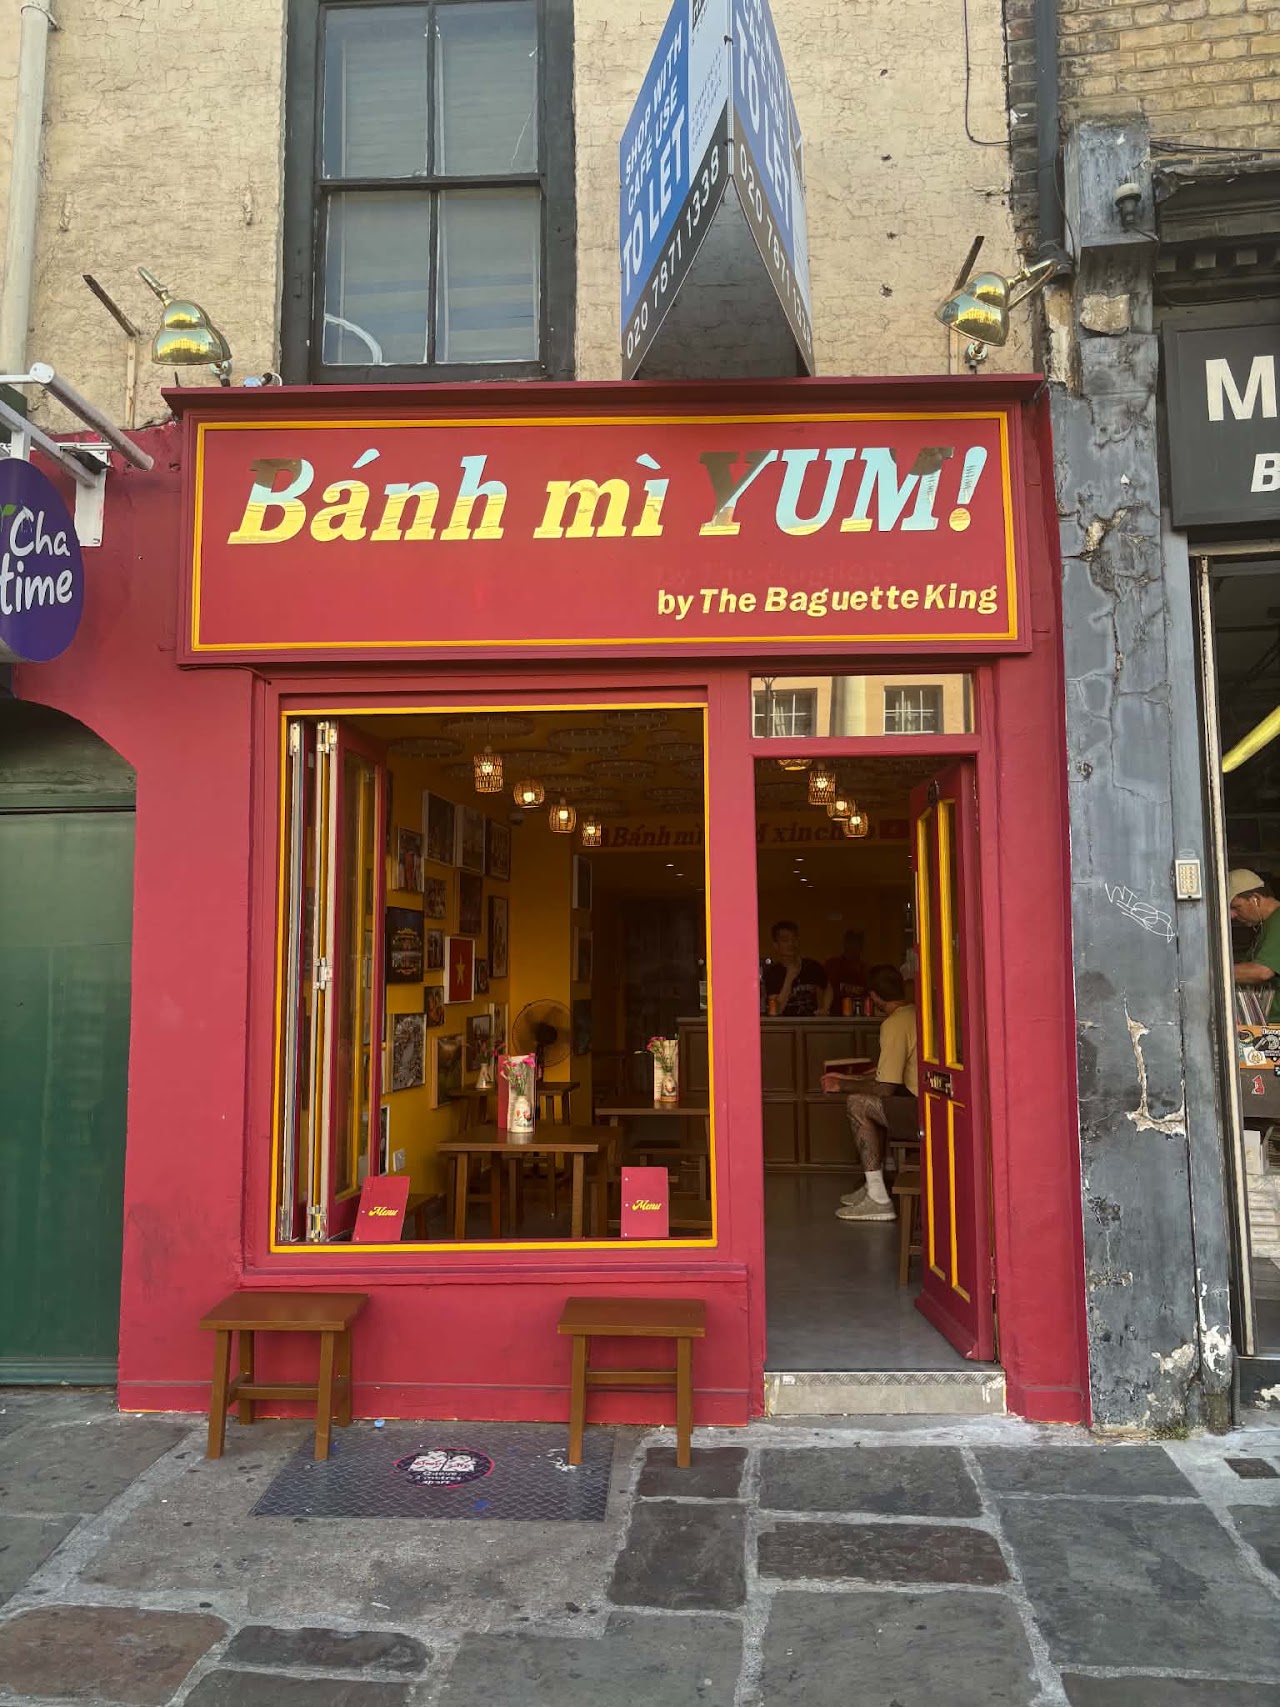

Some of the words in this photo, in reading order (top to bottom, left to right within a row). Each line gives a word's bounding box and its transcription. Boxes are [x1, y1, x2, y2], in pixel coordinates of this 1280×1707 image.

[625, 101, 651, 186] SHOP
[653, 21, 682, 114] WITH
[627, 136, 653, 216] CAFE
[655, 74, 678, 149] USE
[736, 9, 760, 135] TO
[764, 103, 790, 230] LET
[623, 209, 644, 297] TO
[649, 104, 685, 244] LET
[626, 301, 649, 359] 020
[651, 229, 683, 309] 7871
[686, 144, 720, 238] 1338
[740, 143, 764, 224] 020
[766, 214, 791, 297] 7871
[9, 505, 71, 557] Cha
[227, 448, 508, 545] Bánh
[533, 453, 671, 540] mì
[699, 446, 988, 538] YUM!
[0, 552, 73, 616] time
[657, 589, 695, 620] by
[699, 588, 757, 613] The
[764, 585, 920, 617] Baguette
[923, 583, 998, 615] King
[368, 1206, 399, 1217] Menu
[632, 1199, 662, 1212] Menu
